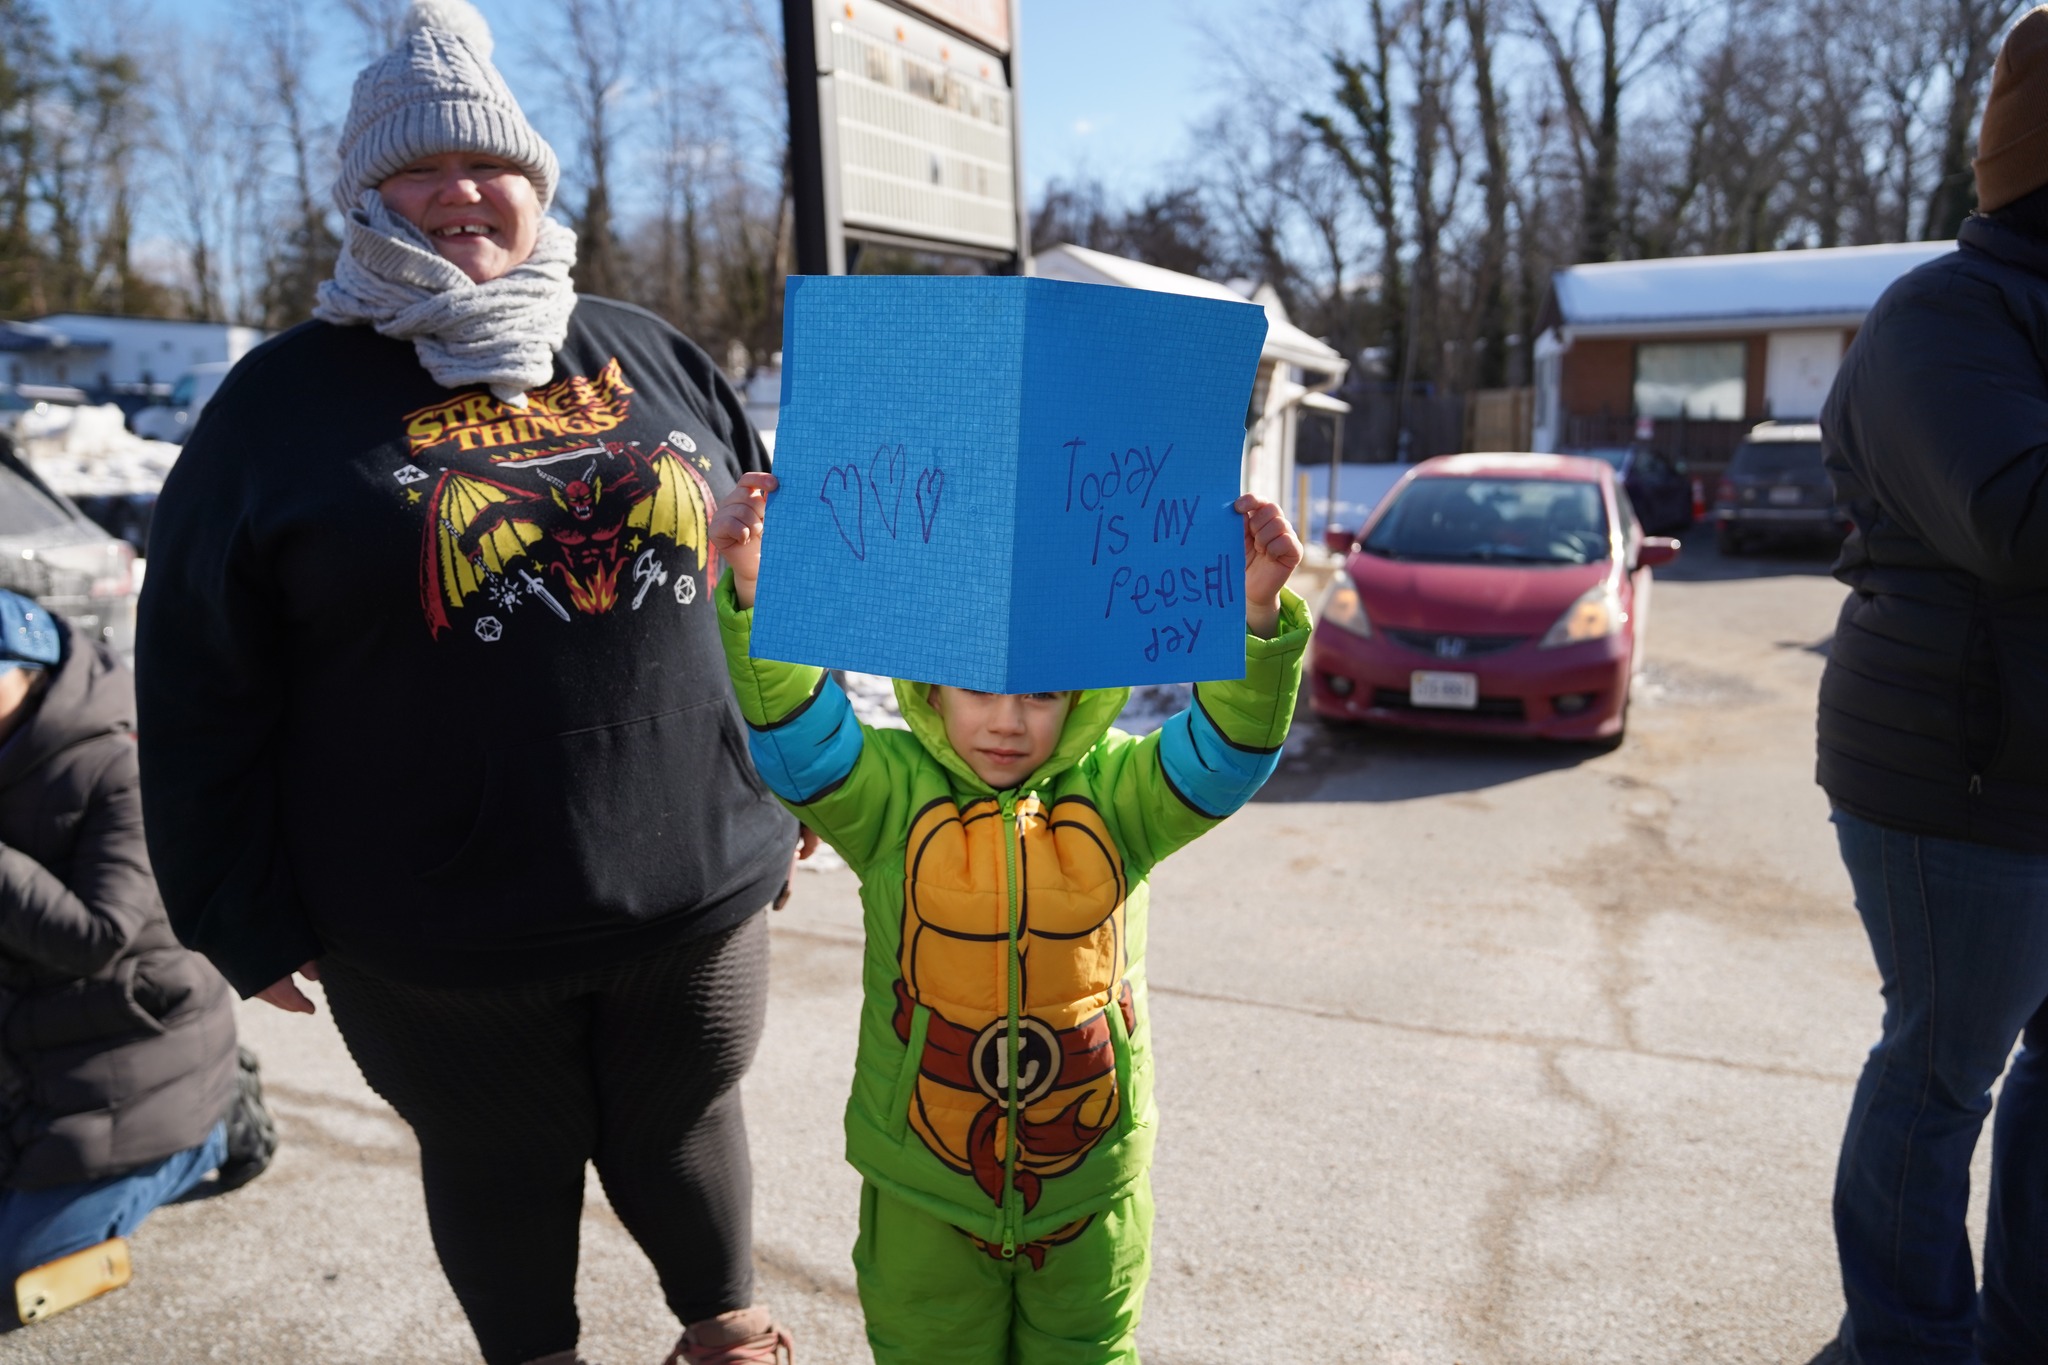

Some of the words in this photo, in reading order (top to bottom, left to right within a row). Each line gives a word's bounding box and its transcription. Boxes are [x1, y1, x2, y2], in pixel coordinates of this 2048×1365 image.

[451, 400, 630, 451] THINGS
[1063, 436, 1174, 512] Today
[1144, 617, 1202, 662] day
